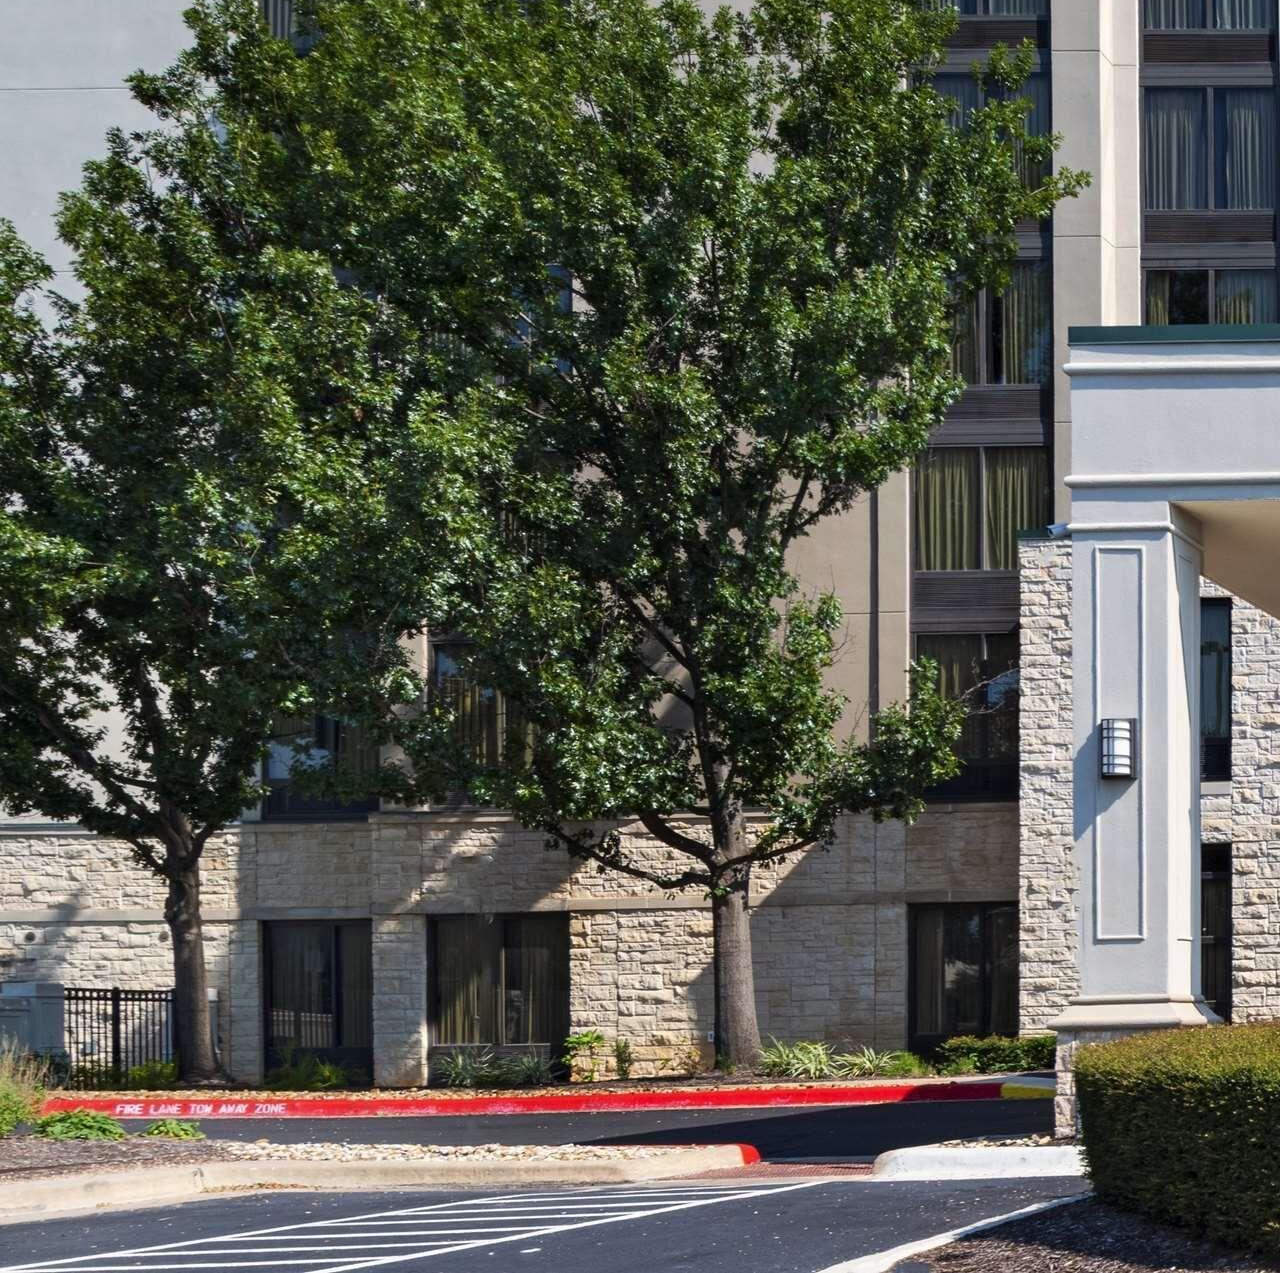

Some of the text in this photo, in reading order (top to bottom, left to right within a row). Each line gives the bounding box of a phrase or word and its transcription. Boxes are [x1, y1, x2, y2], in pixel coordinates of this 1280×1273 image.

[115, 1102, 288, 1115] FIRE LANE TOW AWAY ZONE
